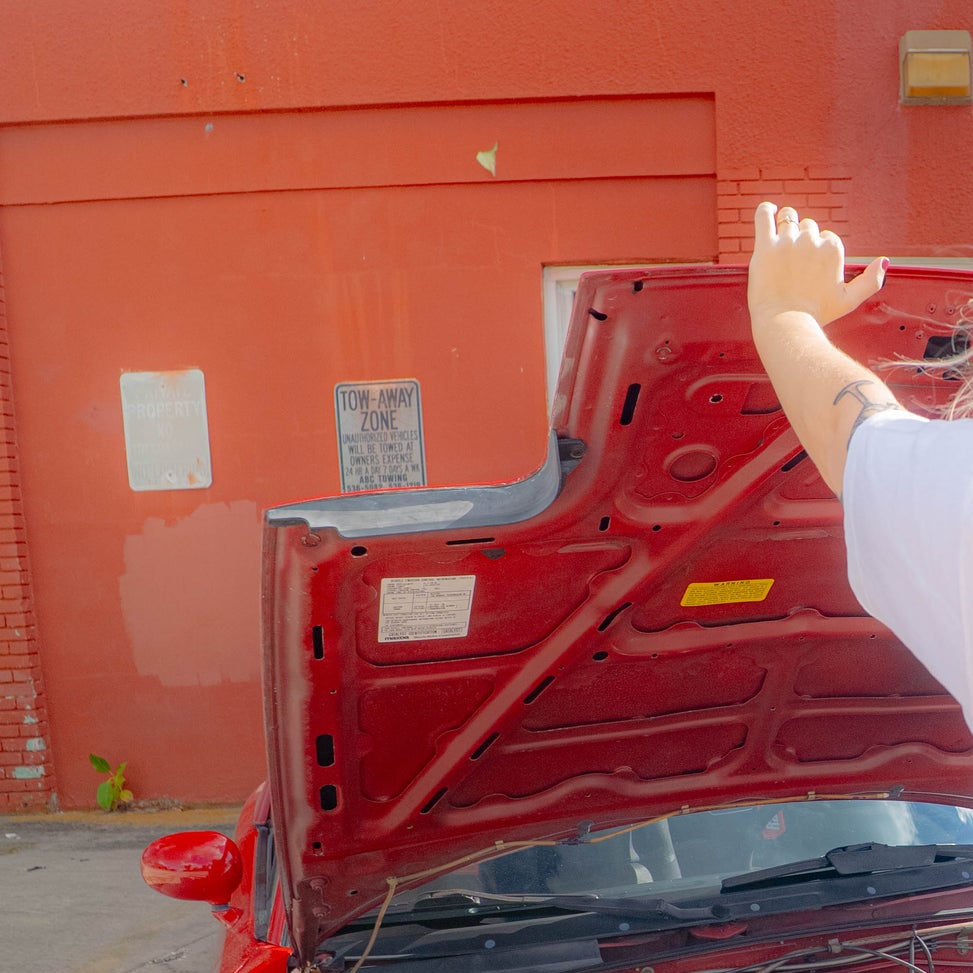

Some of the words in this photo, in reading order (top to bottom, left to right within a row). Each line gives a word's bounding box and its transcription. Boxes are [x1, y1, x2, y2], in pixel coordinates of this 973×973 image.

[340, 387, 415, 411] TOW-AWAY
[361, 410, 398, 431] ZONE
[342, 432, 388, 444] UNAUTHORIZED
[390, 430, 418, 442] VEHICLES
[347, 444, 364, 455] WILL
[367, 443, 377, 454] BE
[379, 442, 403, 453] TOWED
[406, 441, 414, 451] AT
[350, 454, 380, 466] OWNERS
[382, 453, 413, 465] EXPENSE
[359, 475, 374, 483] ABC
[378, 473, 408, 483] TOWING
